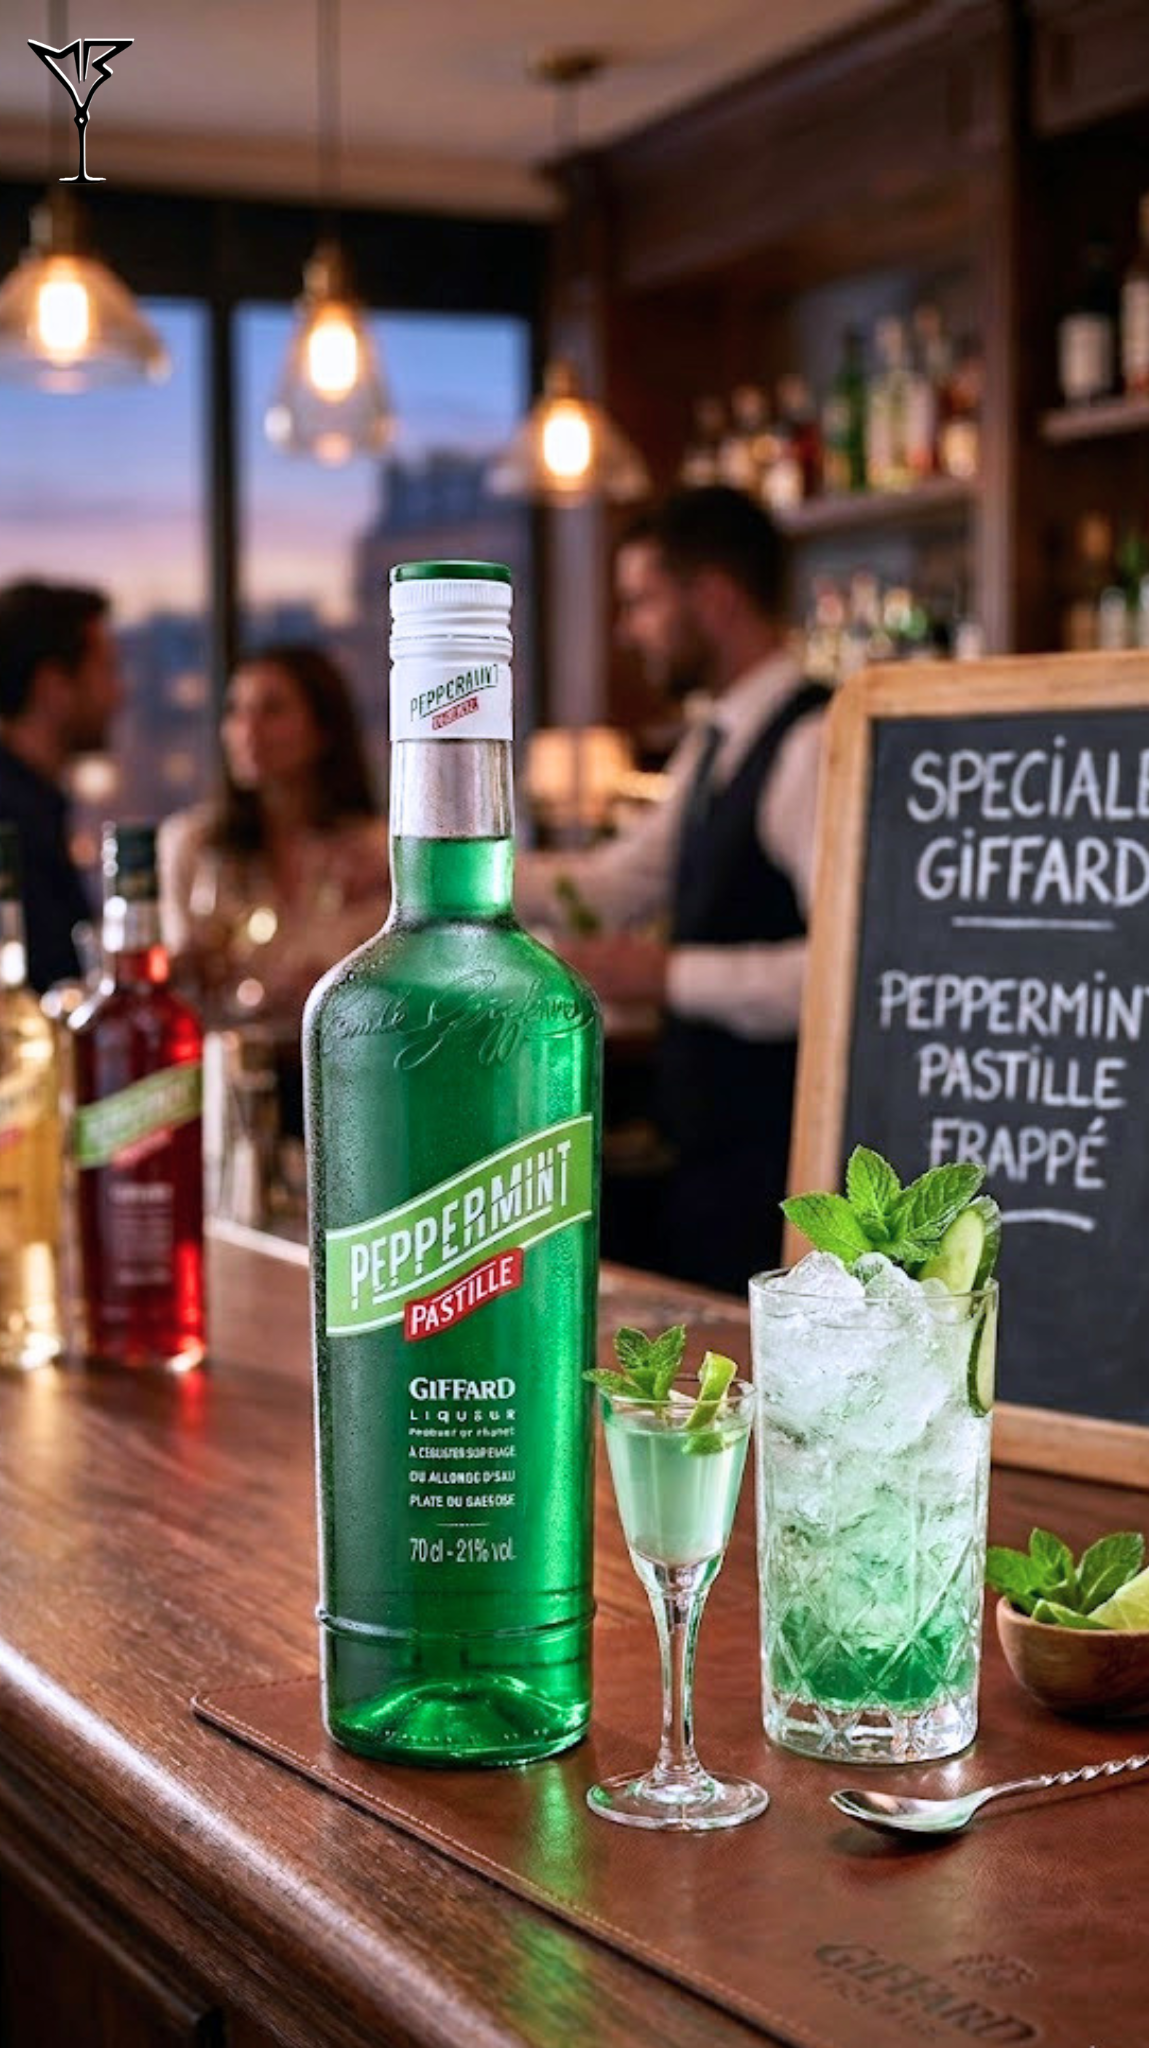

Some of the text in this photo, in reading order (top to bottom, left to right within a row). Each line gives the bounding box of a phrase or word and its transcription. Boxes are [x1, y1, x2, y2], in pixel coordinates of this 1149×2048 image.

[916, 827, 1149, 907] GIFFARD
[880, 969, 1149, 1041] PEPPERMIN
[918, 1043, 1127, 1109] PASTILLE
[929, 1116, 1108, 1189] FRAPPÉ
[350, 1139, 572, 1311] PEPPERMINT
[409, 1255, 514, 1335] PASTILLE
[408, 1376, 516, 1400] GIFFARD
[409, 1494, 443, 1507] PLATE
[456, 1538, 490, 1562] 21%
